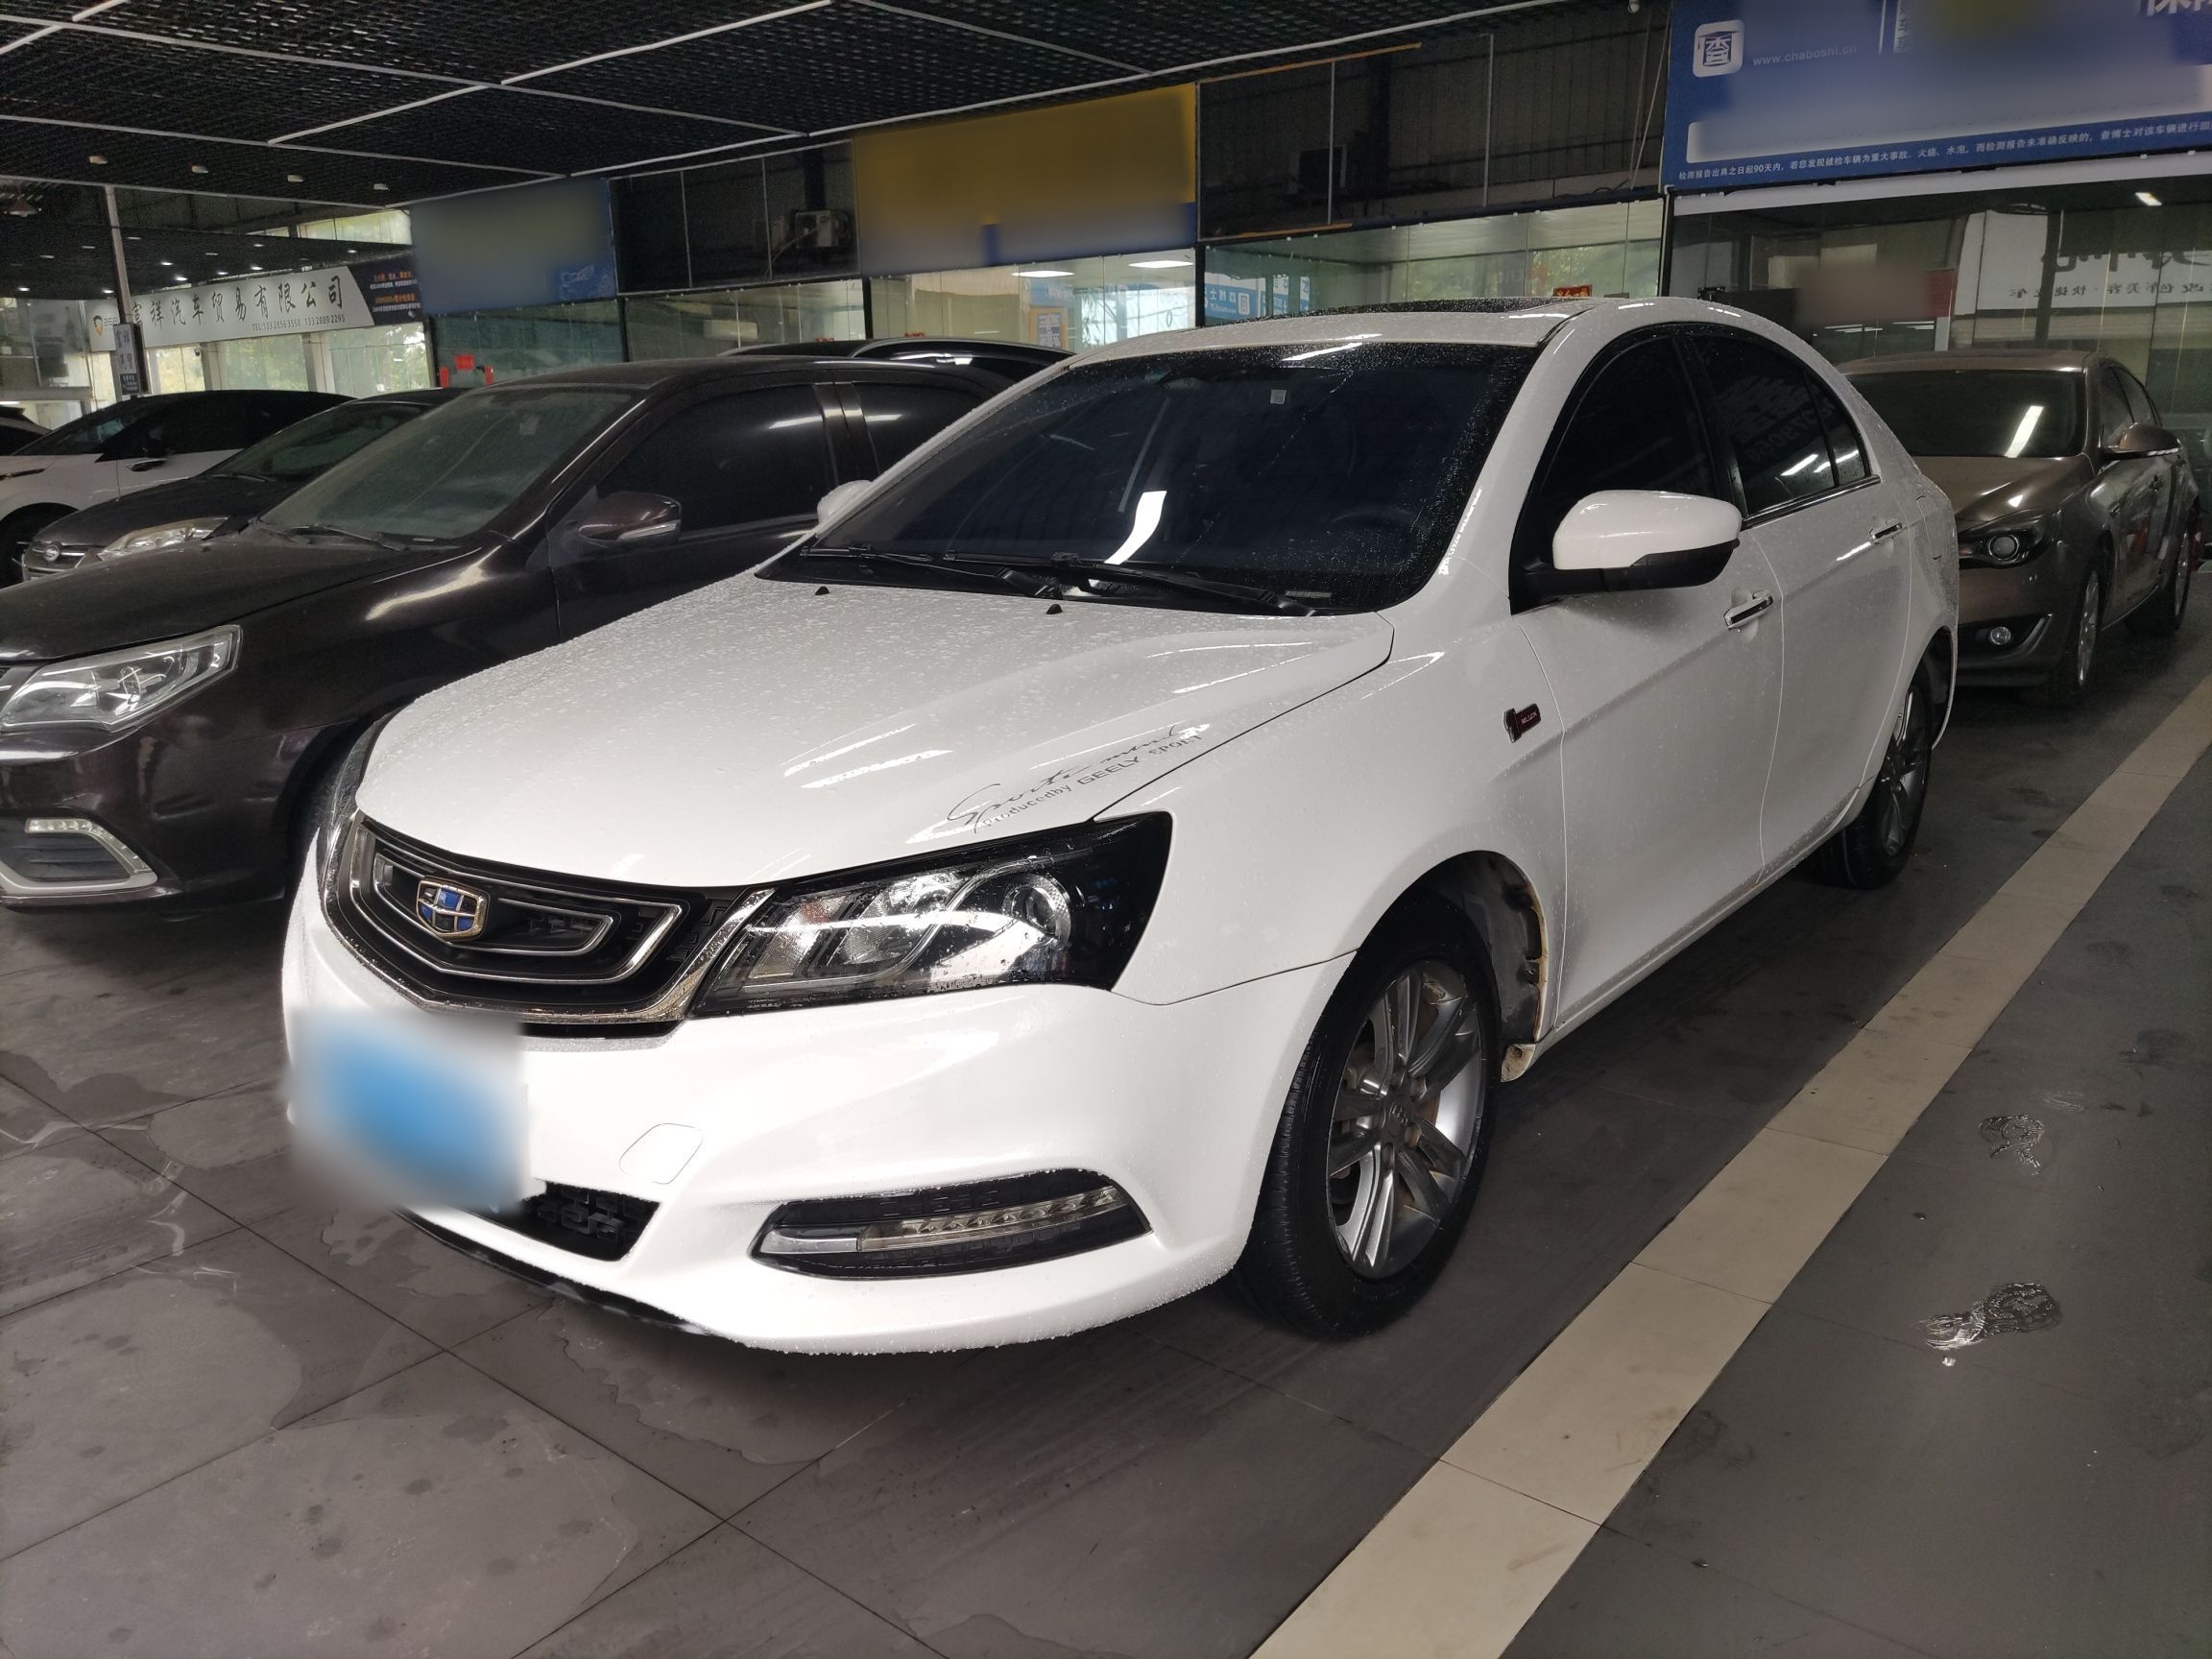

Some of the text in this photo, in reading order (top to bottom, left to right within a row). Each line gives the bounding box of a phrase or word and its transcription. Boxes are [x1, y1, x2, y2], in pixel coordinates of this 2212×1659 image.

[1752, 45, 1858, 67] www.chaboshi.cn
[1076, 756, 1140, 785] GEELY
[1148, 734, 1203, 756] SPORT
